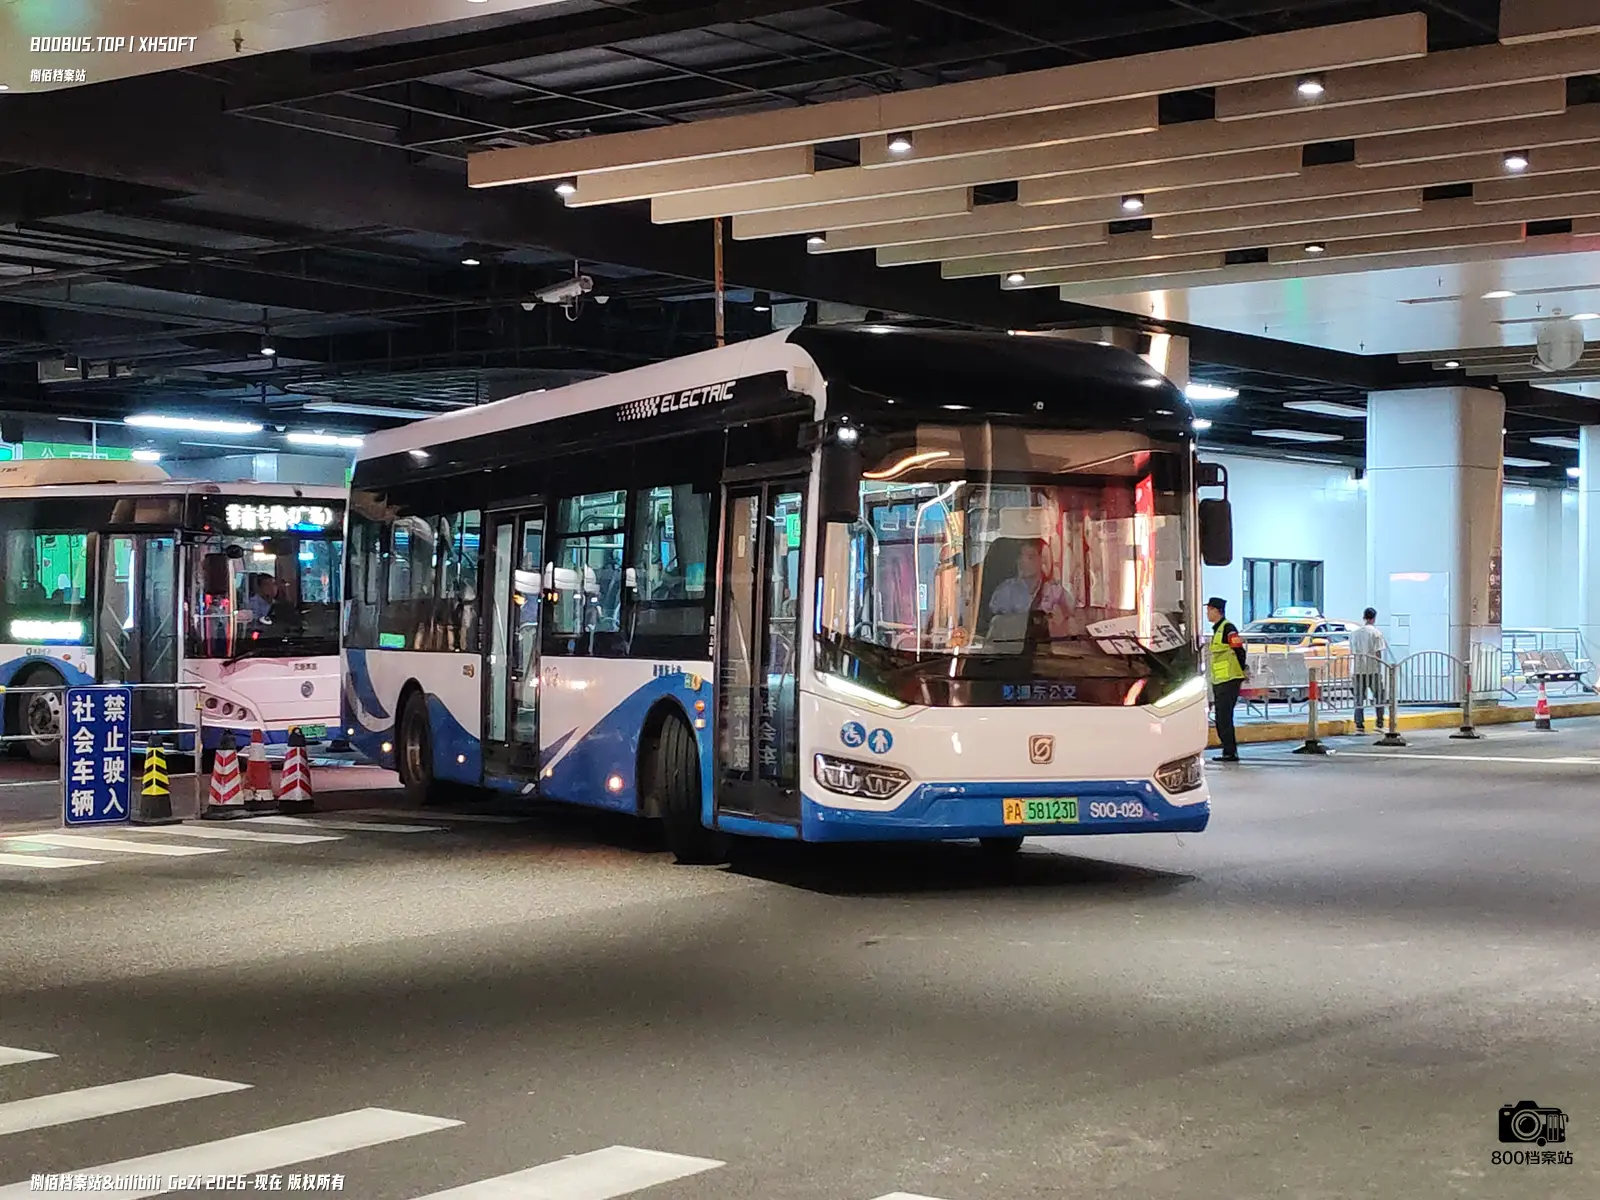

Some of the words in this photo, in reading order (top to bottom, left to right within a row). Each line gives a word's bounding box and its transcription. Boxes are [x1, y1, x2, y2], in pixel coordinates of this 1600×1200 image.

[660, 380, 737, 413] ELECTRIC
[71, 694, 95, 817] 社会车辆
[102, 694, 125, 815] 禁止驶入
